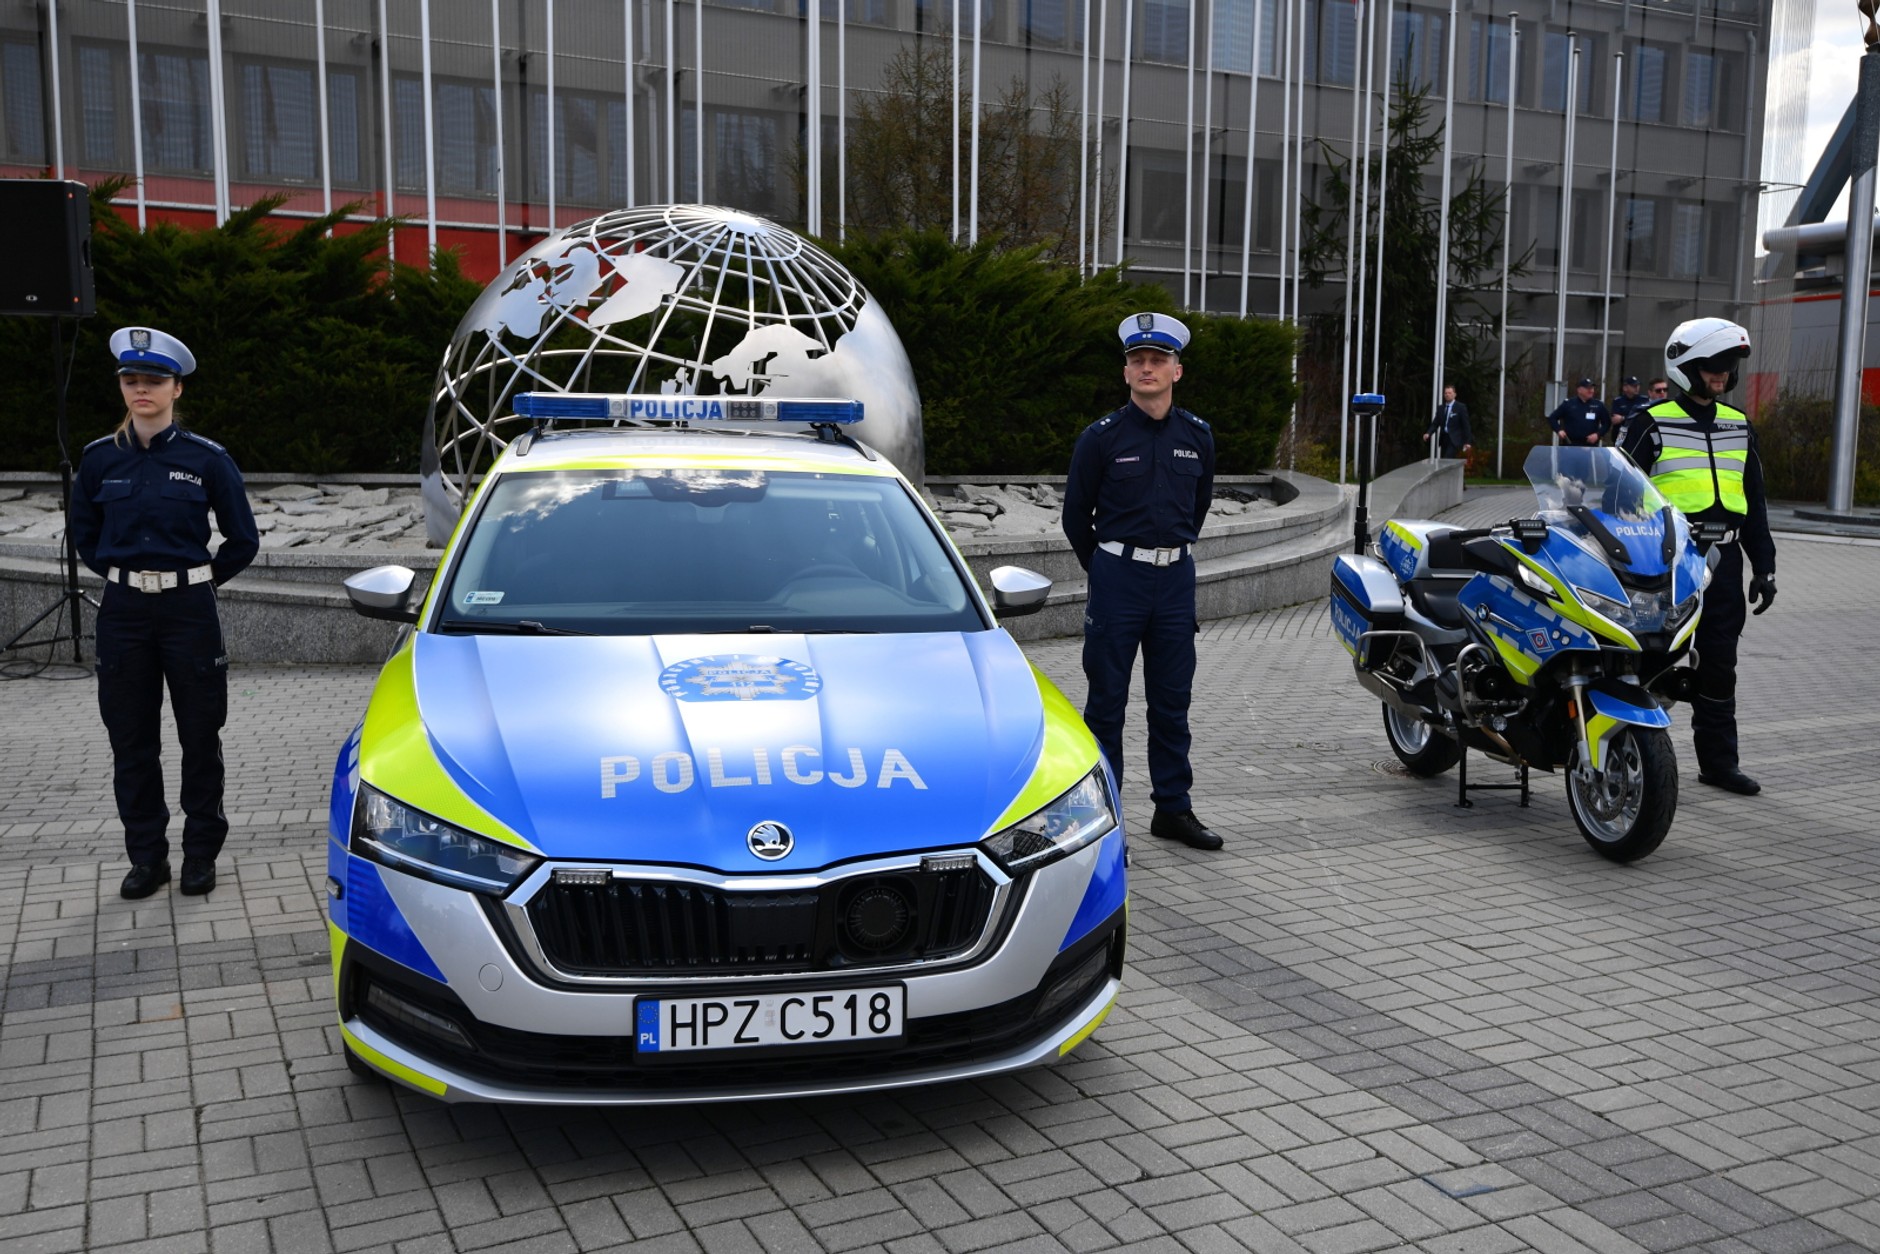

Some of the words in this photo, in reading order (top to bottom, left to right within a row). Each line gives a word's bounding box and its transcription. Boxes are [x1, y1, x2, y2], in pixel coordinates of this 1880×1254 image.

[630, 400, 723, 420] POLICJA
[1173, 449, 1199, 459] POLICJA
[169, 471, 202, 486] POLICJA
[1616, 526, 1662, 537] POLICJA
[1334, 603, 1361, 637] POLICJA
[600, 744, 929, 799] POLICJA
[670, 1000, 760, 1047] HPZ
[780, 992, 891, 1040] C518
[640, 1033, 657, 1045] PL
